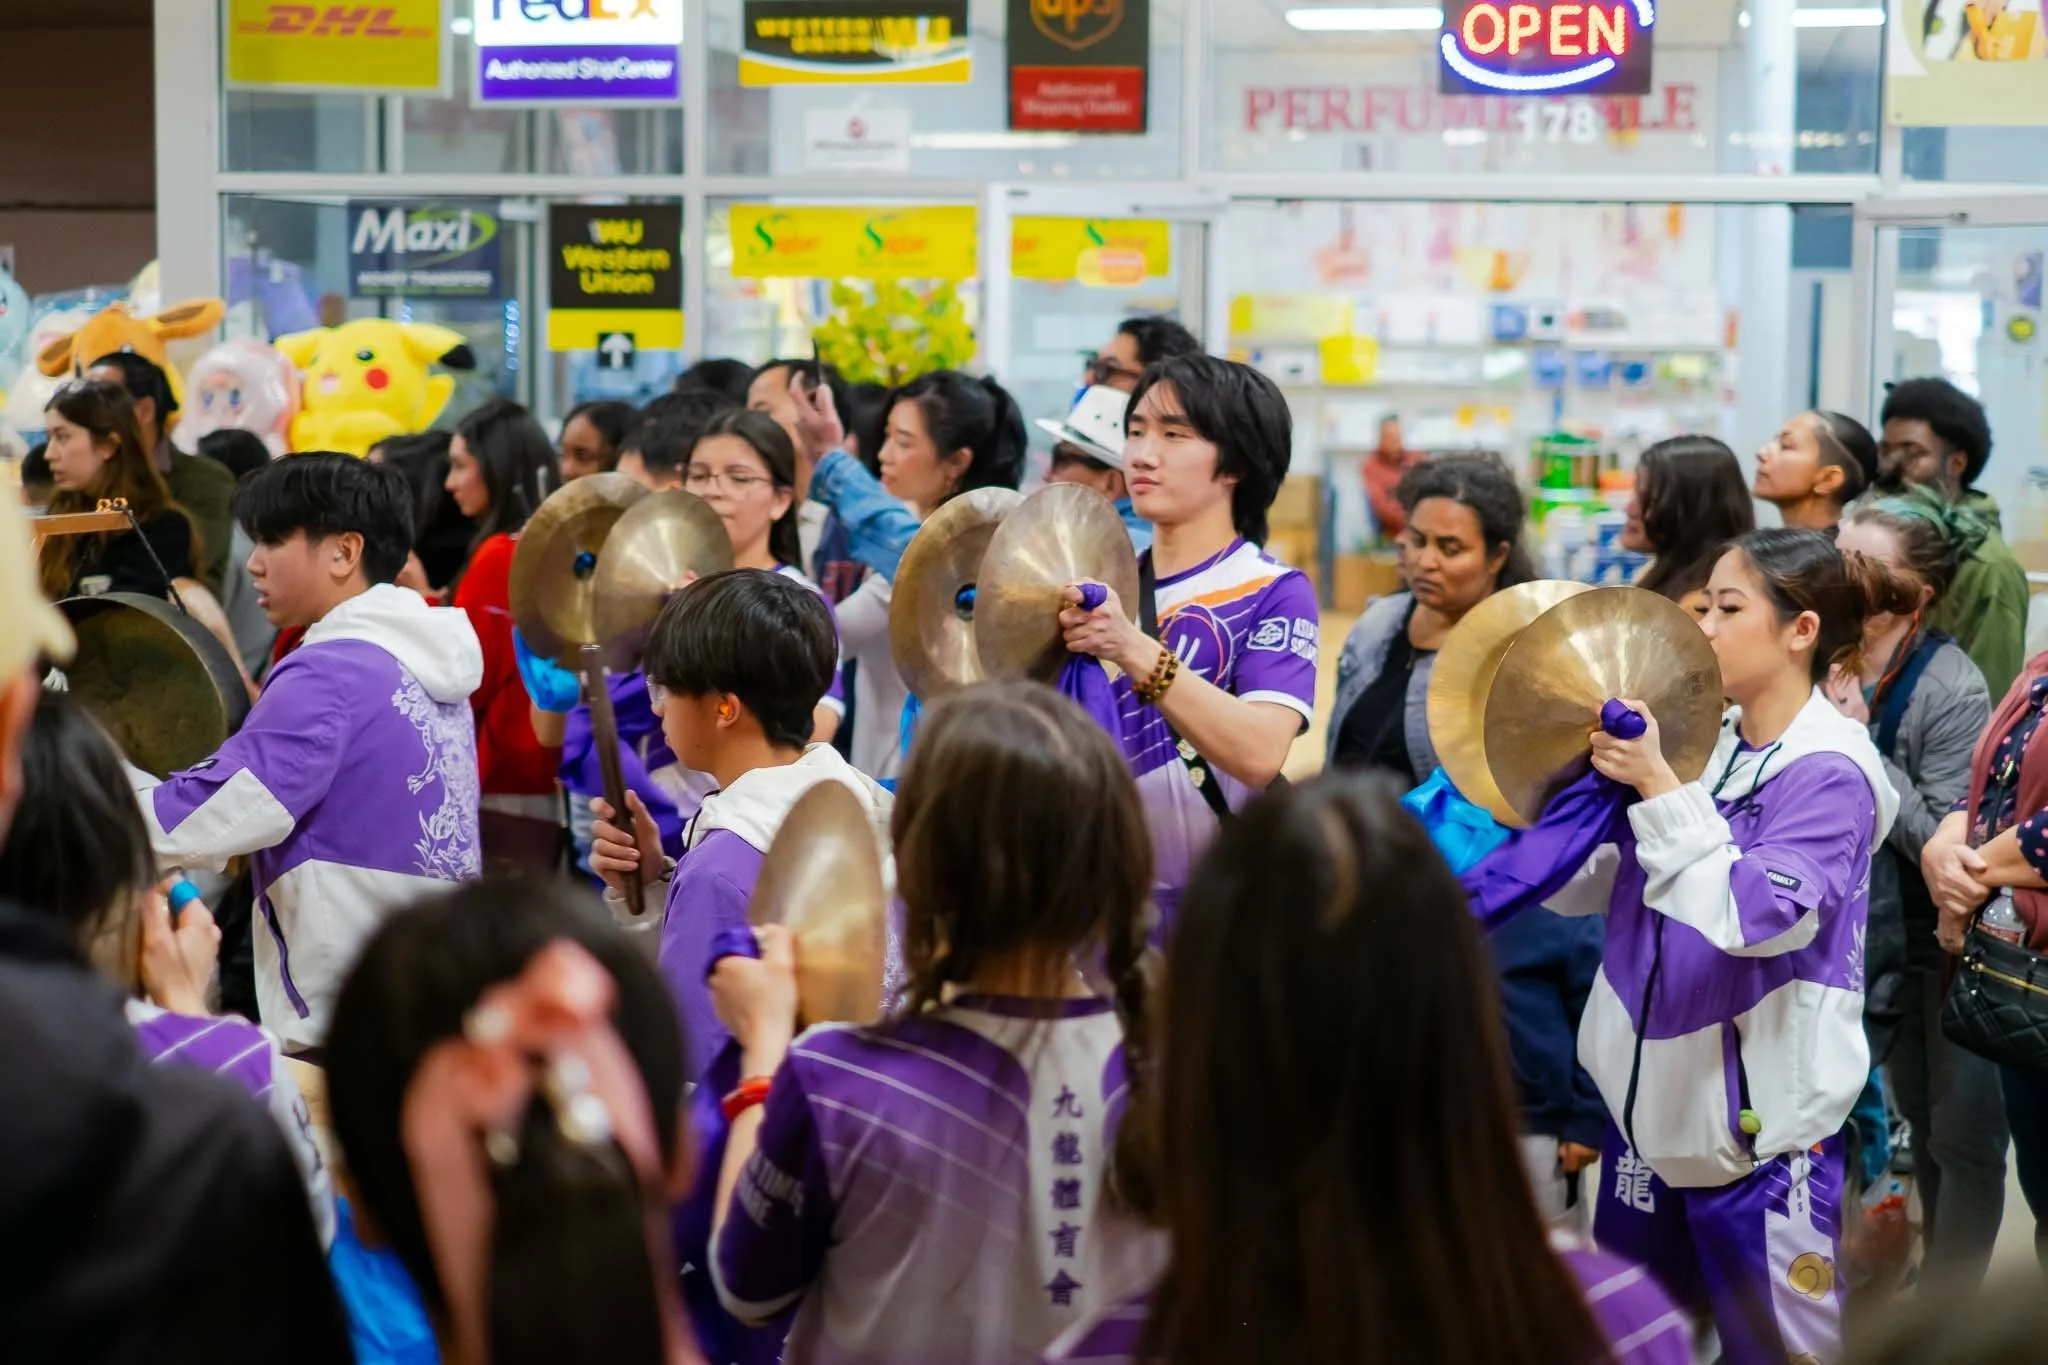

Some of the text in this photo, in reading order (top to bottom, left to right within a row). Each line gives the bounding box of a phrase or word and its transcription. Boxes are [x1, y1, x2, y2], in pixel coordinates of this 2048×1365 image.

[266, 5, 403, 36] DHL
[1462, 3, 1626, 55] OPEN
[1514, 102, 1597, 142] 178
[353, 208, 473, 253] Maxi
[562, 244, 671, 270] Western
[579, 271, 655, 293] Union
